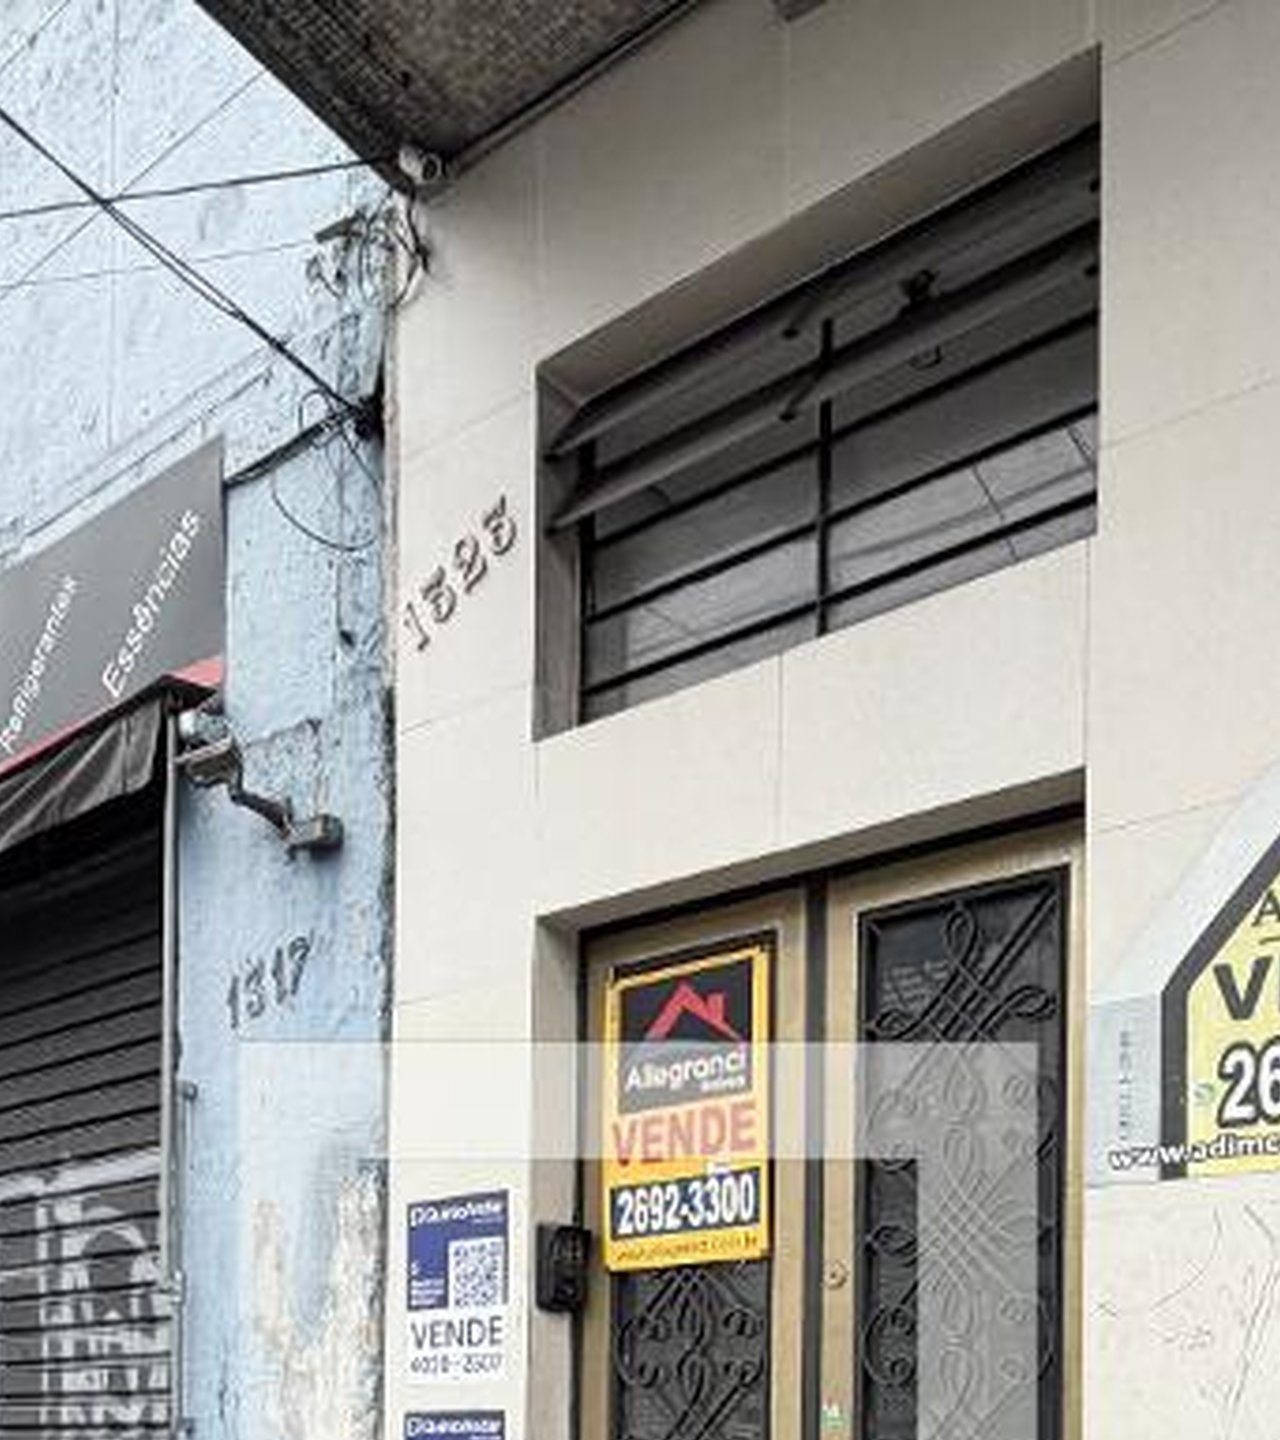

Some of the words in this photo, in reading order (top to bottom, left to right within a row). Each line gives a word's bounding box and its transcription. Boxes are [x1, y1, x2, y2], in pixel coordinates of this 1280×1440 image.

[612, 1101, 757, 1167] VENDE
[617, 1173, 756, 1235] 2692-3300
[410, 1315, 503, 1350] VENDE
